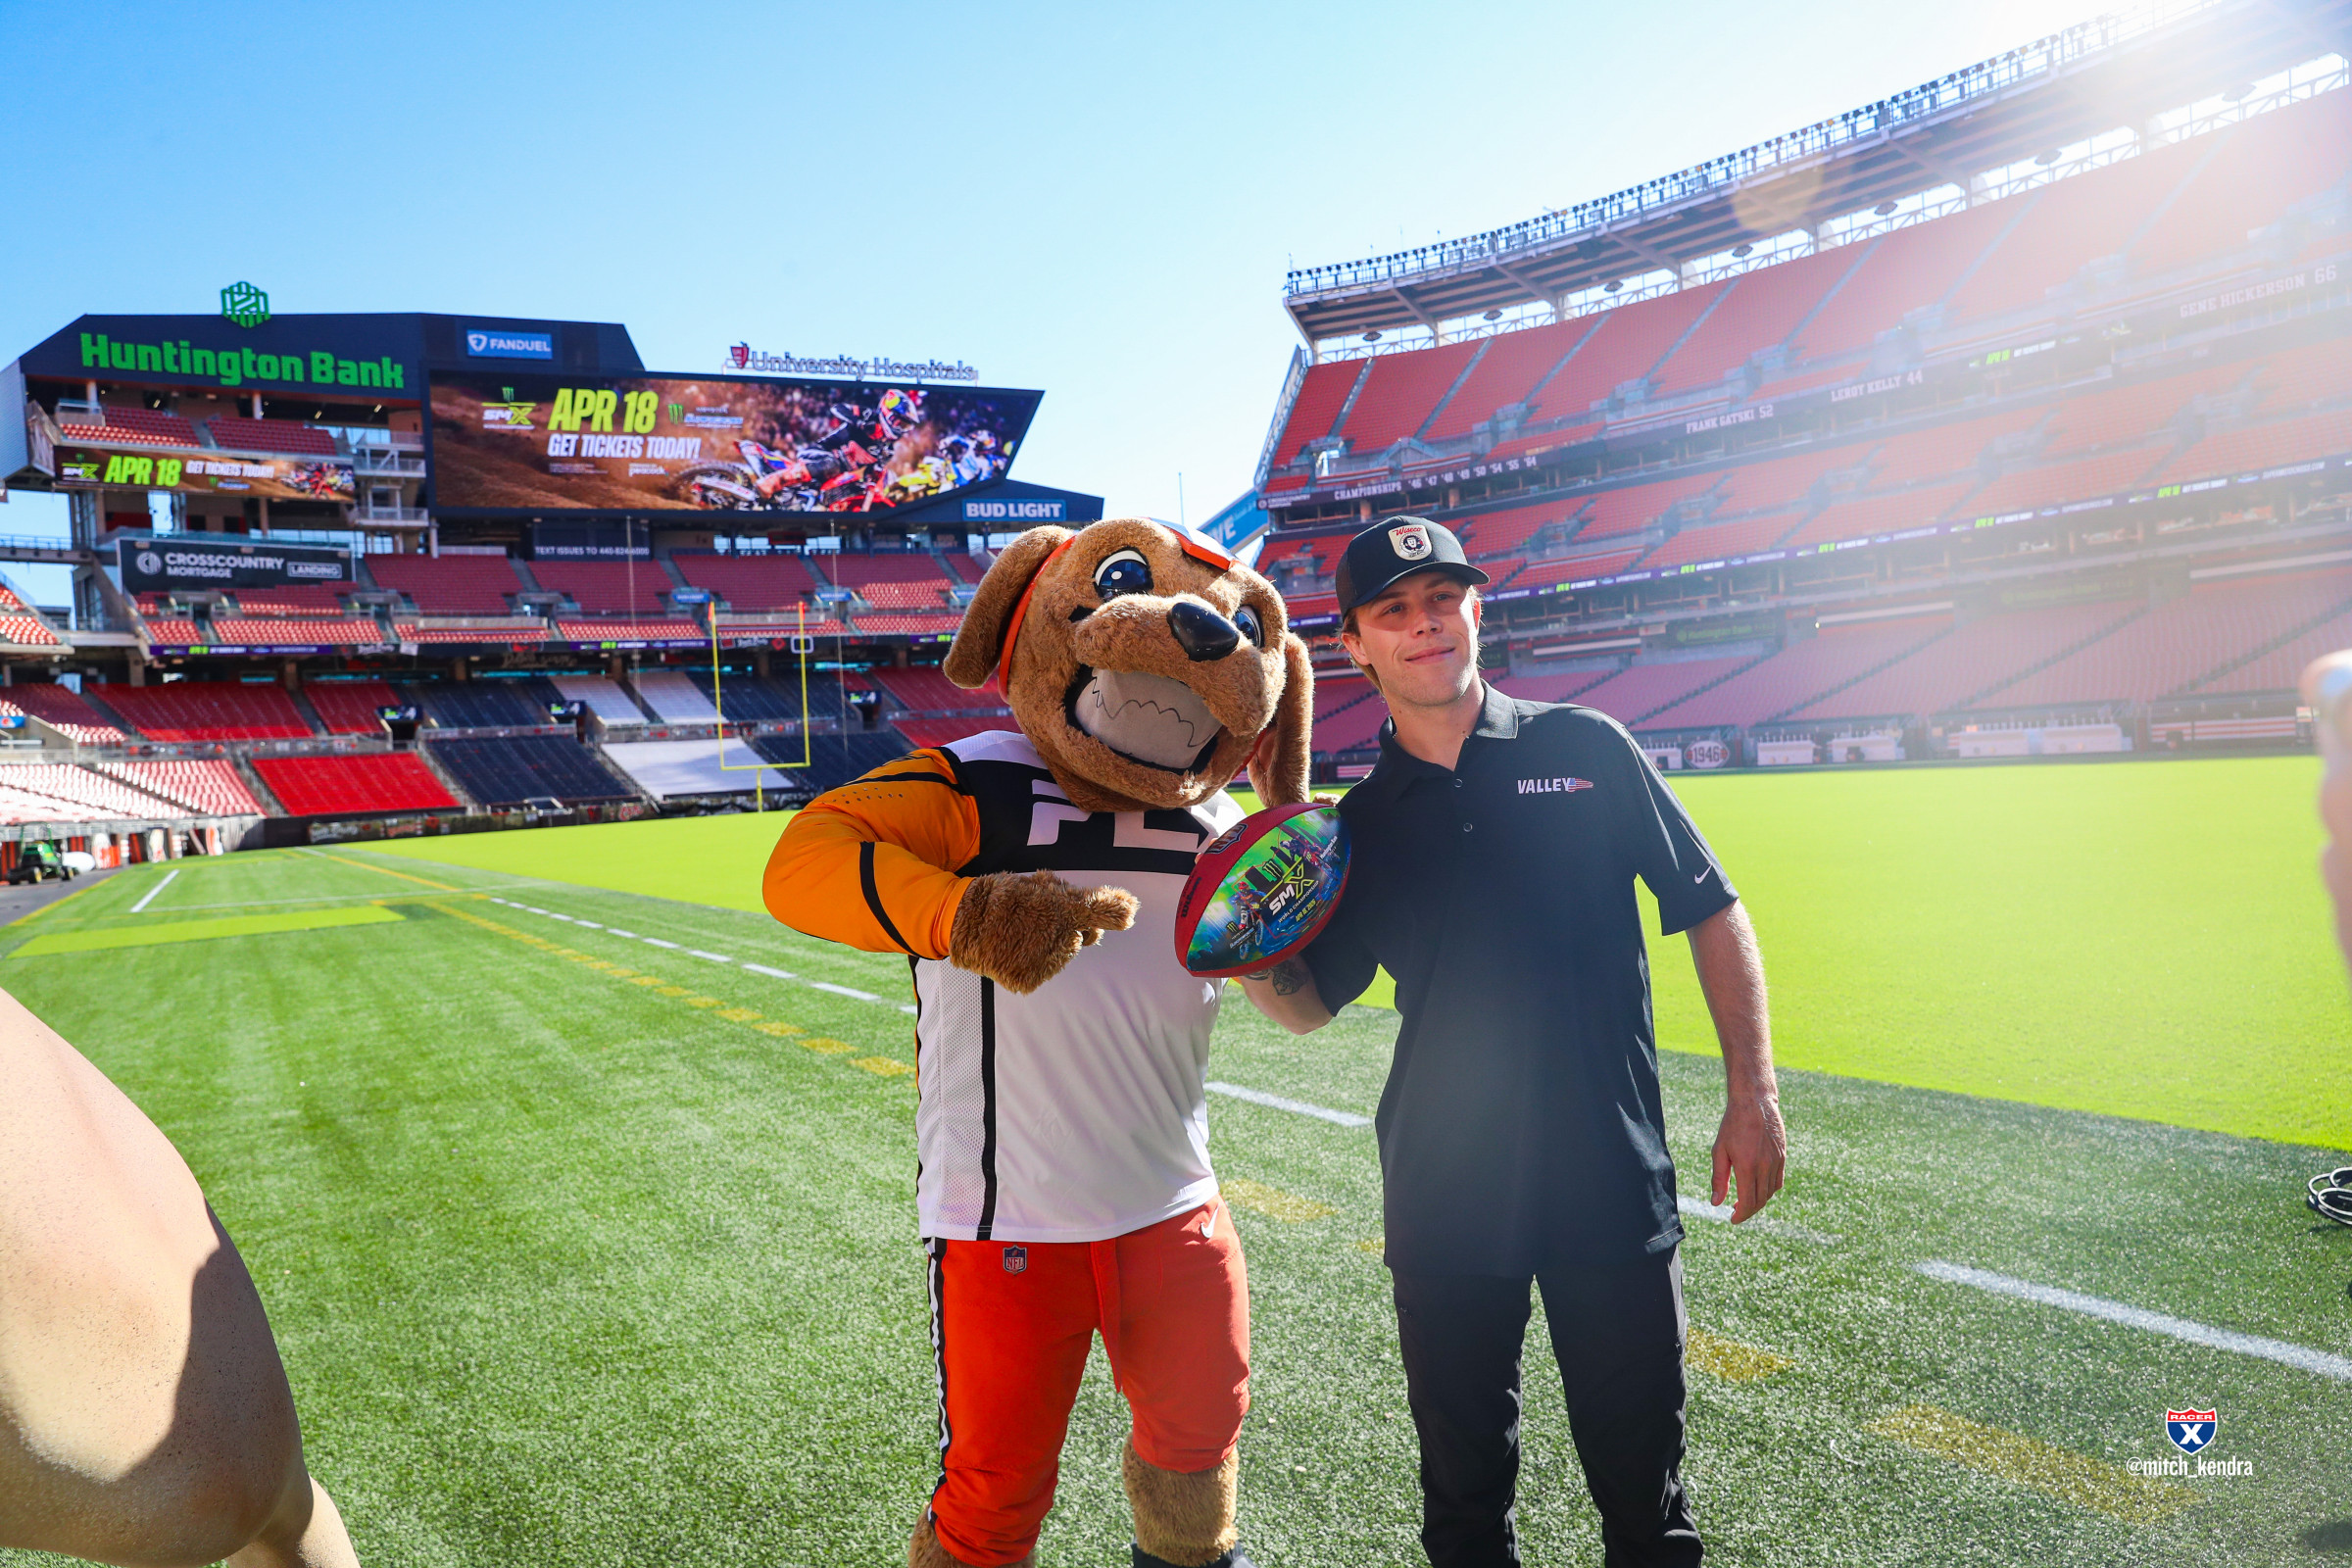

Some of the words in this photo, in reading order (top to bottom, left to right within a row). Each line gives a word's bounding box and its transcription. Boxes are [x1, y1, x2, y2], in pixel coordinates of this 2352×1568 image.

[2180, 297, 2217, 318] GENE
[2221, 272, 2306, 309] HICKERSON
[2315, 265, 2337, 285] 66
[489, 338, 551, 352] FANDUEL
[80, 332, 305, 386] Huntington
[310, 351, 405, 389] Bank
[752, 351, 868, 381] University
[874, 357, 977, 384] Hospitals
[1831, 383, 1865, 403] LEROY
[1867, 374, 1902, 394] KELLY
[1906, 368, 1924, 385] 44
[547, 387, 618, 433] APR
[622, 390, 660, 434] 18
[1686, 416, 1719, 434] FRANK
[1719, 408, 1755, 427] GATSKI
[1759, 403, 1775, 418] 52
[547, 433, 579, 458] GET
[580, 434, 644, 460] TICKETS
[645, 436, 702, 460] TODAY!
[103, 455, 154, 486] APR
[156, 458, 183, 487] 18
[1334, 481, 1402, 501] CHAMPIONSHIPS
[965, 502, 1007, 518] BUD
[1007, 502, 1062, 518] LIGHT
[1393, 526, 1423, 536] Wiseco
[534, 545, 556, 556] TEXT
[557, 546, 584, 556] ISSUES
[586, 546, 599, 556] TO
[164, 552, 285, 570] CROSSCOUNTRY
[291, 564, 340, 576] LANDING
[166, 565, 233, 579] MORTGAGE
[1692, 745, 1720, 763] 1946
[1517, 777, 1571, 795] VALLEY
[1268, 862, 1315, 916] SMX
[1006, 1257, 1024, 1270] NFL
